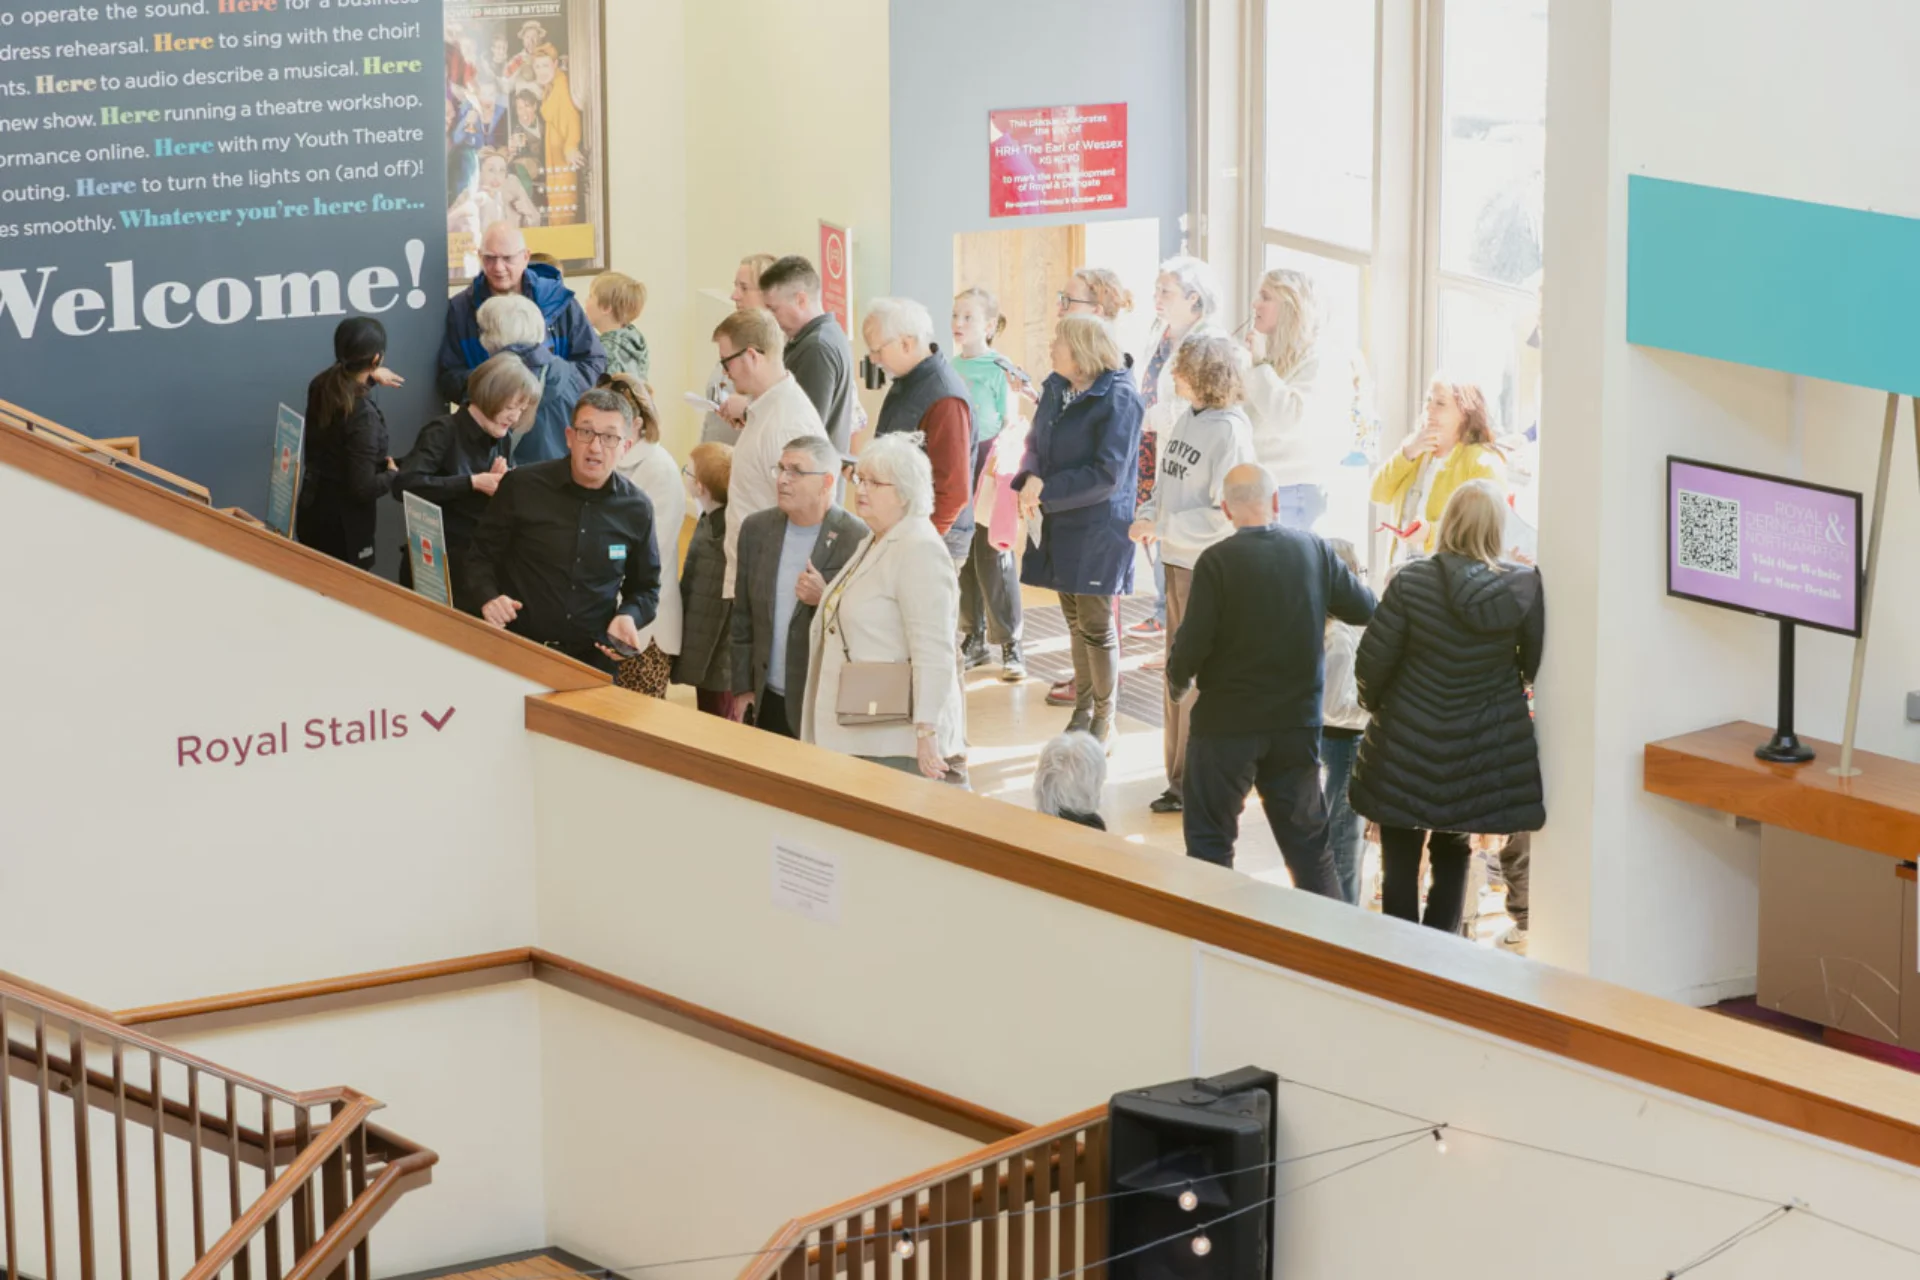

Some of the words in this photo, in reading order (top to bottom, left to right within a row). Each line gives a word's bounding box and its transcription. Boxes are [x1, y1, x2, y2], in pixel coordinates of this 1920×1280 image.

[0, 12, 14, 25] o
[21, 6, 99, 27] operate
[105, 3, 138, 20] the
[144, 0, 210, 18] sound.
[218, 0, 278, 14] Here
[338, 0, 420, 8] busi
[522, 4, 561, 14] MYSTERY
[0, 45, 51, 61] dress
[55, 37, 149, 58] rehearsal.
[153, 32, 215, 53] Here
[218, 33, 239, 49] to
[243, 31, 282, 49] sing
[287, 27, 328, 45] with
[332, 25, 363, 42] the
[368, 22, 421, 40] choir!
[35, 74, 97, 94] Here
[100, 75, 121, 91] to
[125, 71, 178, 89] audio
[183, 66, 263, 85] describe
[268, 68, 280, 82] a
[284, 60, 359, 80] musical.
[363, 56, 422, 76] Here
[0, 118, 38, 132] new
[43, 113, 97, 130] show.
[101, 106, 161, 126] Here
[164, 103, 236, 121] running
[240, 105, 252, 118] a
[256, 98, 323, 117] theatre
[327, 93, 423, 112] workshop.
[1009, 118, 1027, 128] This
[0, 149, 81, 168] ormance
[85, 143, 150, 162] online.
[154, 137, 215, 157] Here
[218, 136, 258, 153] with
[262, 136, 291, 152] my
[295, 130, 349, 149] Youth
[352, 127, 424, 144] Theatre
[1034, 127, 1049, 136] the
[995, 145, 1019, 157] HRH
[1022, 143, 1042, 154] The
[1045, 142, 1066, 153] Earl
[1068, 140, 1080, 151] of
[1082, 139, 1123, 150] Wessex
[2, 184, 71, 202] outing.
[76, 178, 137, 197] Here
[141, 177, 162, 193] to
[167, 175, 207, 192] turn
[212, 171, 243, 188] the
[248, 168, 301, 189] lights
[305, 168, 330, 183] on
[335, 161, 379, 183] (and
[384, 159, 424, 179] off)!
[1003, 175, 1012, 184] to
[1014, 172, 1035, 183] mark
[1018, 182, 1028, 192] of
[0, 223, 19, 238] es
[24, 214, 116, 235] smoothly.
[119, 206, 231, 229] Whatever
[236, 200, 309, 227] you're
[313, 196, 368, 217] here
[372, 193, 425, 213] for...
[0, 239, 427, 340] Welcome!
[1774, 501, 1822, 527] ROYAL
[1825, 512, 1848, 547] &
[1752, 552, 1775, 568] Visit
[1801, 561, 1843, 582] Website
[176, 721, 288, 767] Royal
[303, 708, 409, 750] Stalls
